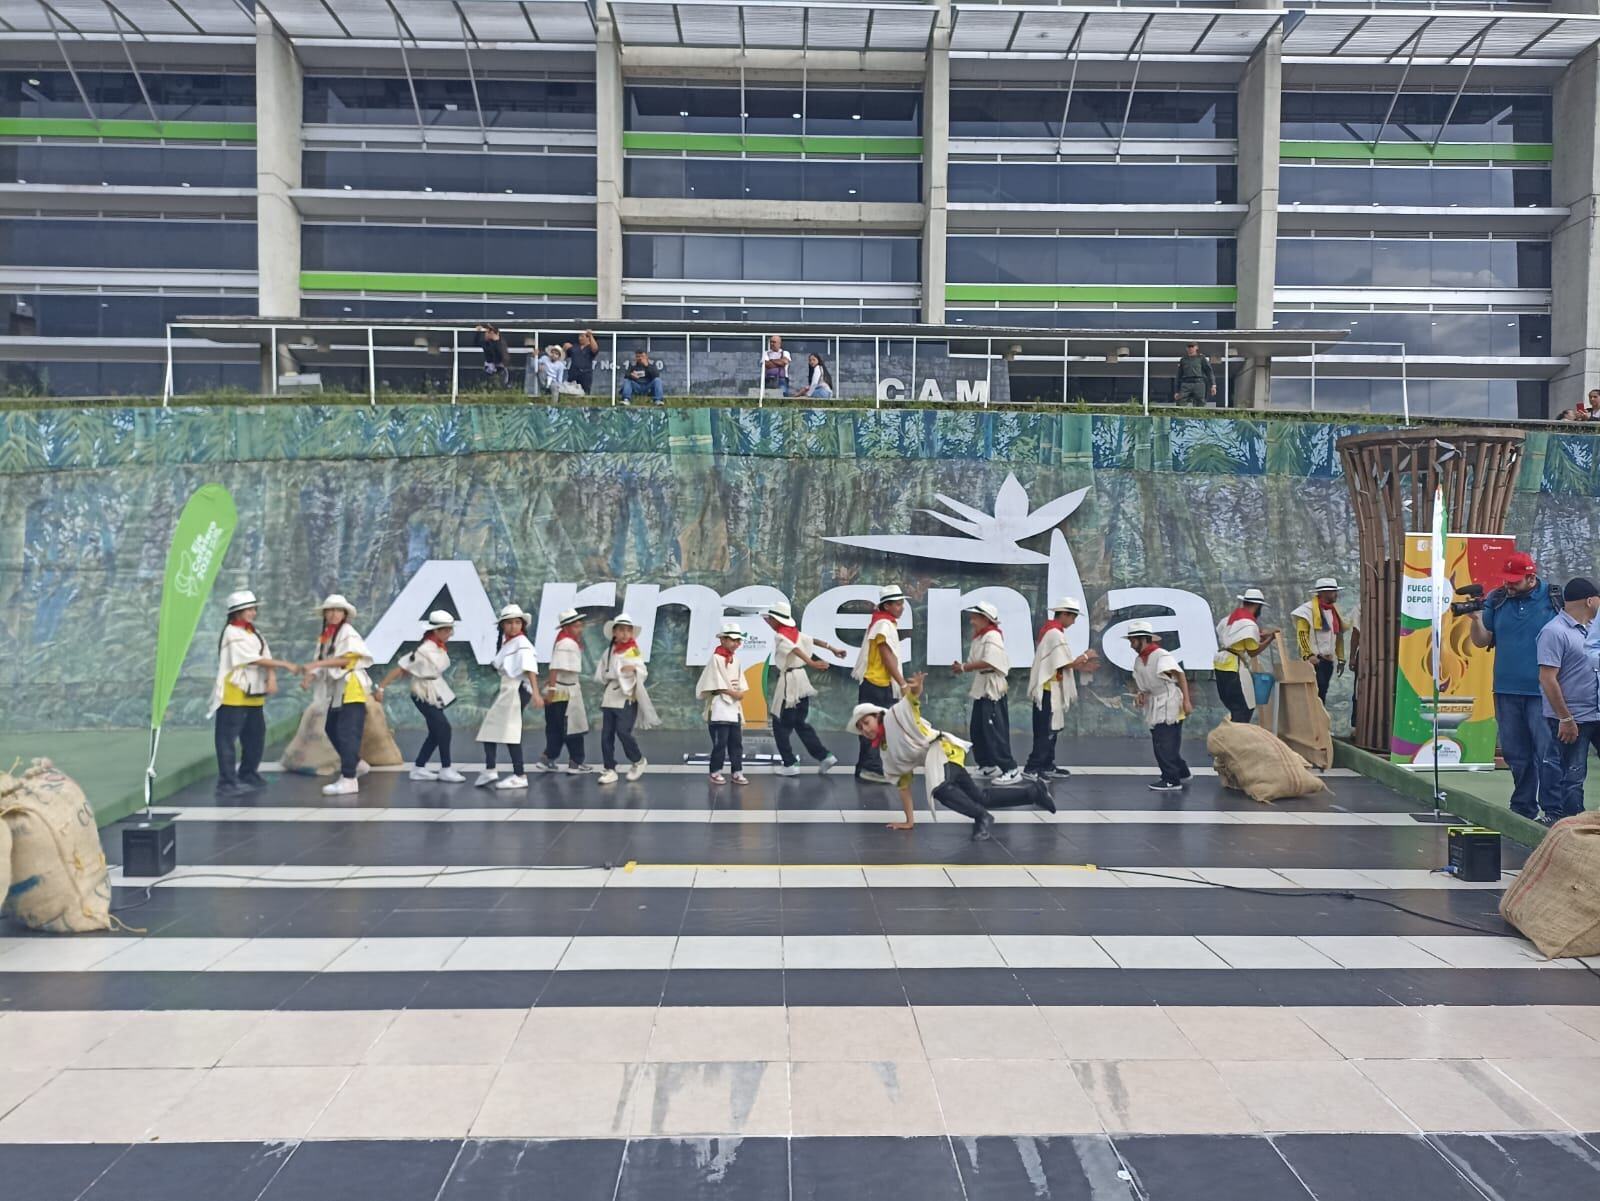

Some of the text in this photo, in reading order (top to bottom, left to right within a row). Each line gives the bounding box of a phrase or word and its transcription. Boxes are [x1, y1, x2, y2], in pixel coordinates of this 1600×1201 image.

[878, 377, 990, 402] CAM
[366, 529, 1219, 671] Armenia
[1407, 595, 1450, 604] DEPORO
